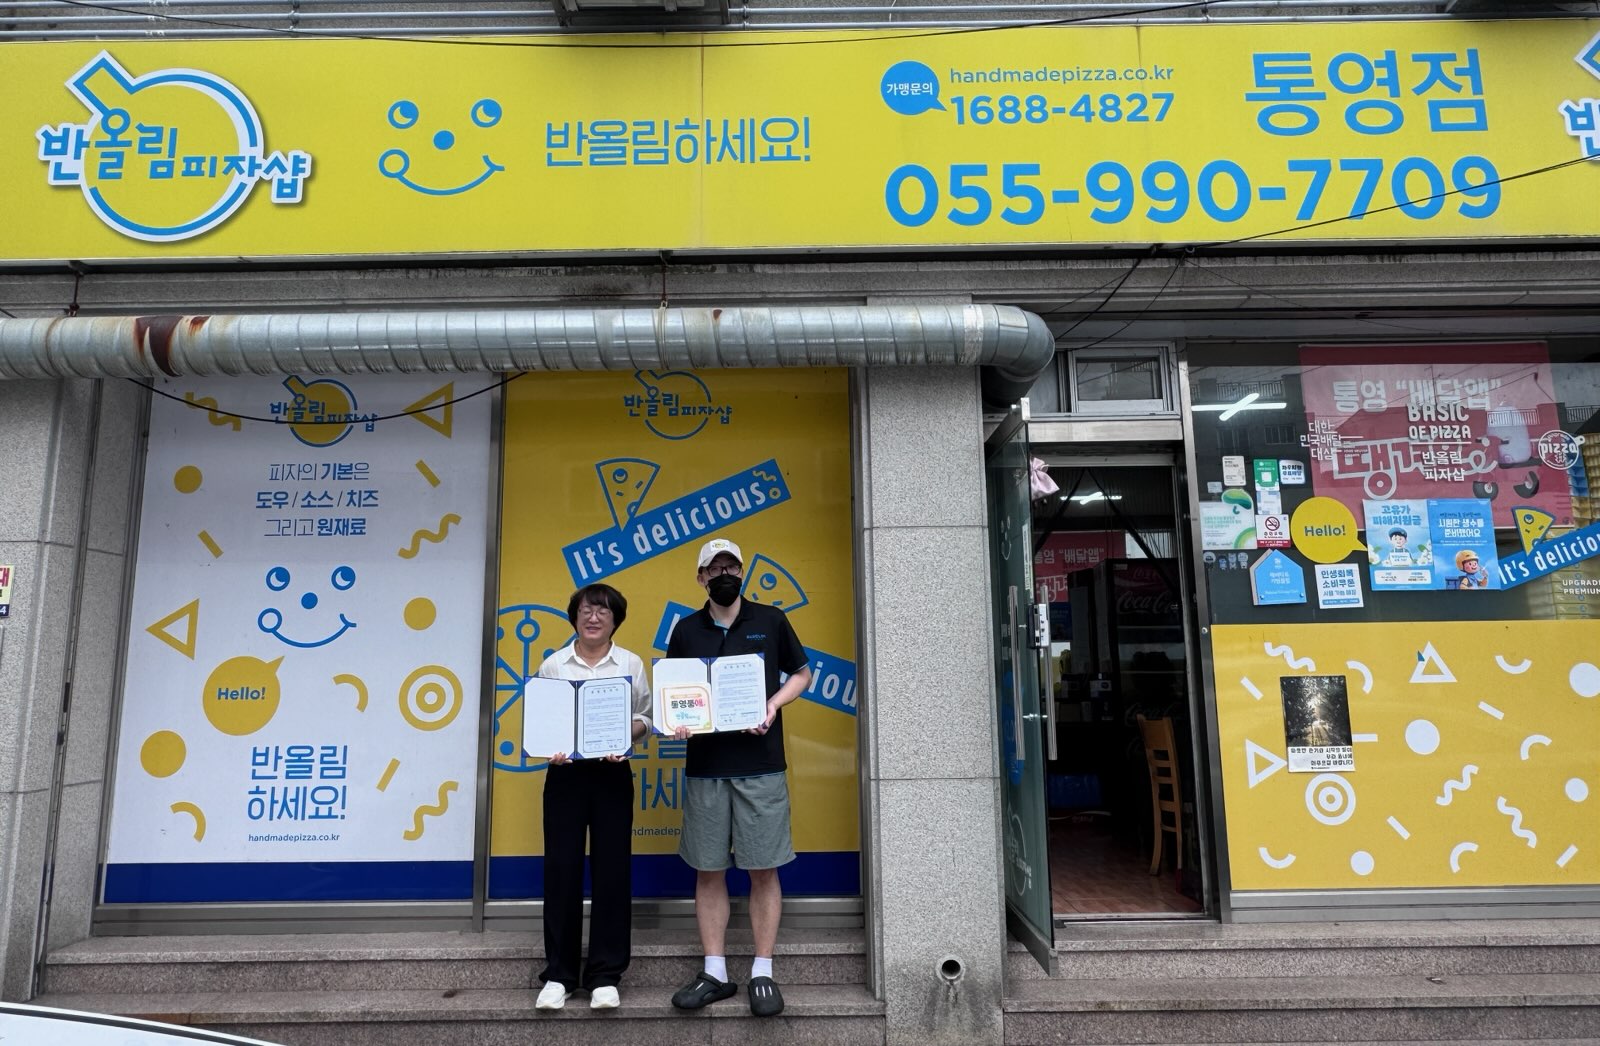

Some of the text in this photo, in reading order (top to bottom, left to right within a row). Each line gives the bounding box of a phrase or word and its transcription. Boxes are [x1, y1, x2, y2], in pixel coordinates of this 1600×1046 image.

[950, 64, 1174, 84] handmadepizza.co.kr
[886, 82, 934, 96] 가맹문의
[1245, 48, 1488, 136] 통영점
[950, 92, 1175, 125] 1688-4827
[545, 115, 812, 167] 반올림하세요!
[884, 156, 1502, 228] 055-990-7709
[1332, 380, 1388, 413] 통영
[1407, 403, 1470, 422] BASIC
[1308, 420, 1338, 434] 대한
[1408, 424, 1472, 439] OF PIZZA
[1422, 451, 1463, 466] 반올림
[1540, 439, 1578, 460] pizza
[269, 462, 370, 481] 피자의 기본은
[255, 490, 289, 509] 도우
[300, 490, 334, 508] 소스
[345, 489, 379, 508] 치즈
[1381, 504, 1412, 515] 고유가
[263, 517, 366, 537] 그리고 원재료
[573, 482, 767, 580] It's delicious
[1304, 524, 1346, 537] Hello!
[1498, 559, 1530, 585] It's
[217, 686, 266, 701] Hello!
[250, 744, 349, 781] 반올림
[247, 784, 347, 822] 하세요!
[248, 833, 341, 843] handmadepizza.co.kr
